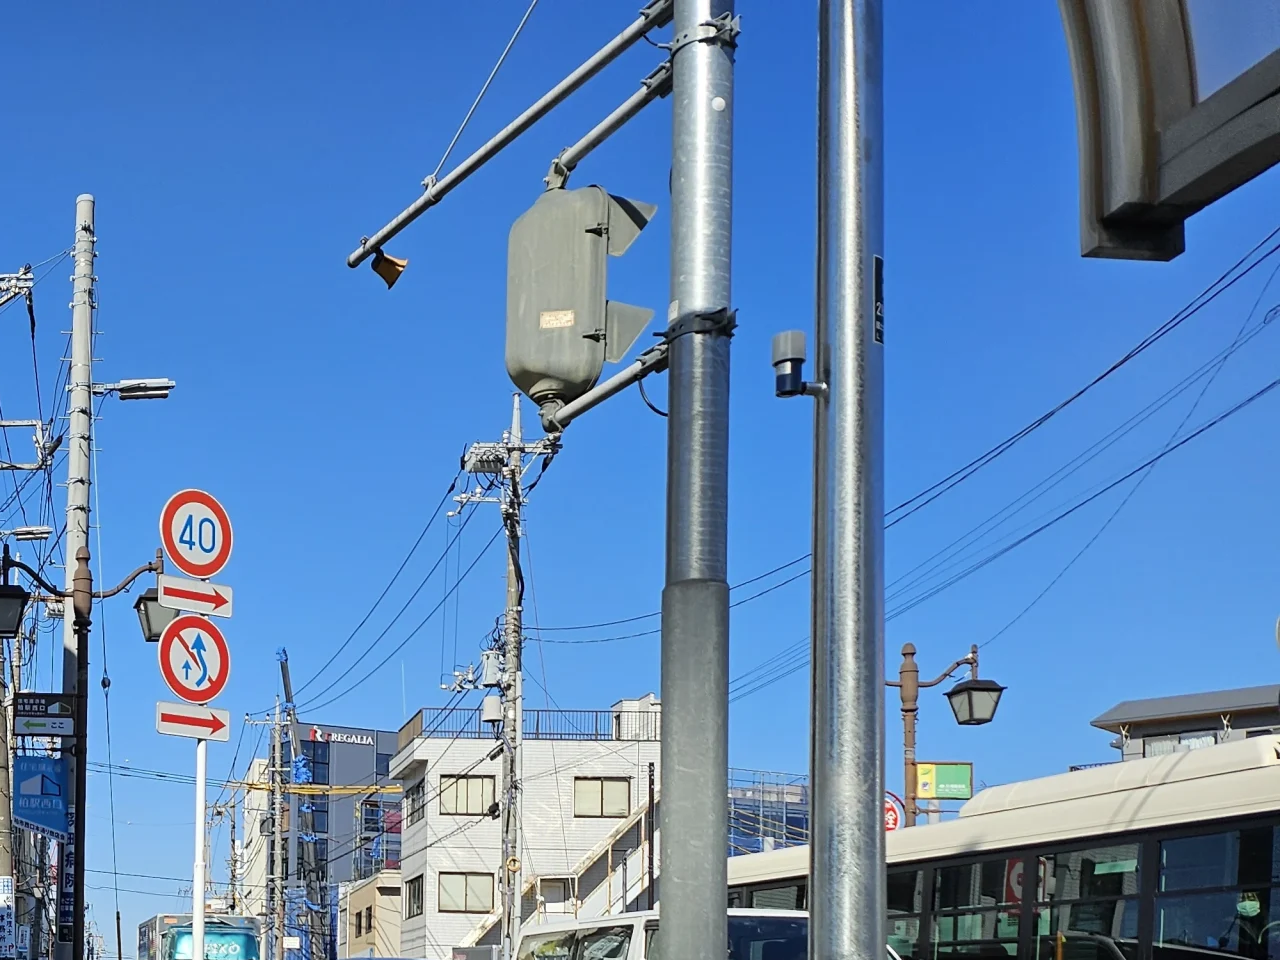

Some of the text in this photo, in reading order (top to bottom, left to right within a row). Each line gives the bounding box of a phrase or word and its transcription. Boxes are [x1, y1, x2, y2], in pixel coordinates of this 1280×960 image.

[179, 514, 216, 553] 40
[50, 721, 65, 729] ここ
[18, 797, 63, 810] 柏駅西口
